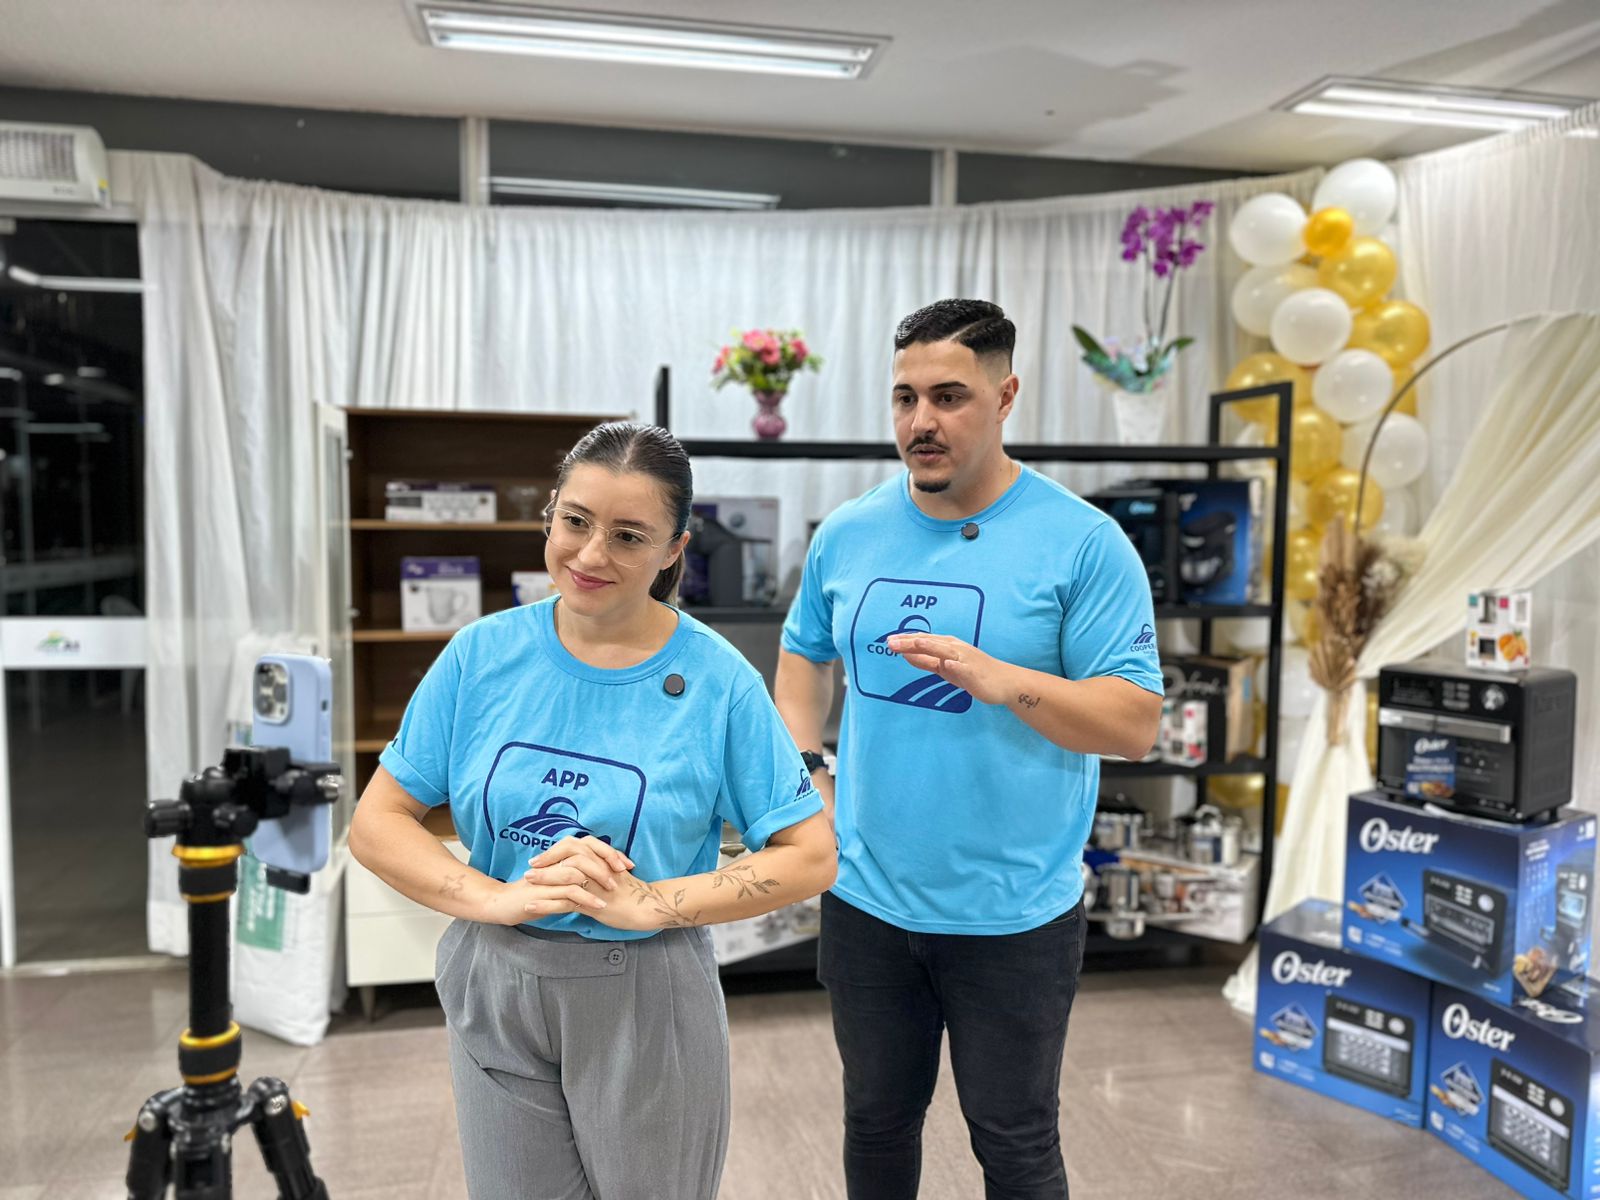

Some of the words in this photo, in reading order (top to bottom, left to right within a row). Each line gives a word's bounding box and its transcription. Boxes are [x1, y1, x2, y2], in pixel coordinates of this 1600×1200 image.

[900, 594, 938, 610] APP
[867, 643, 898, 657] COO
[541, 768, 590, 791] APP
[1359, 817, 1440, 854] Oster
[1271, 951, 1352, 987] Oster
[1442, 1003, 1515, 1051] Oster
